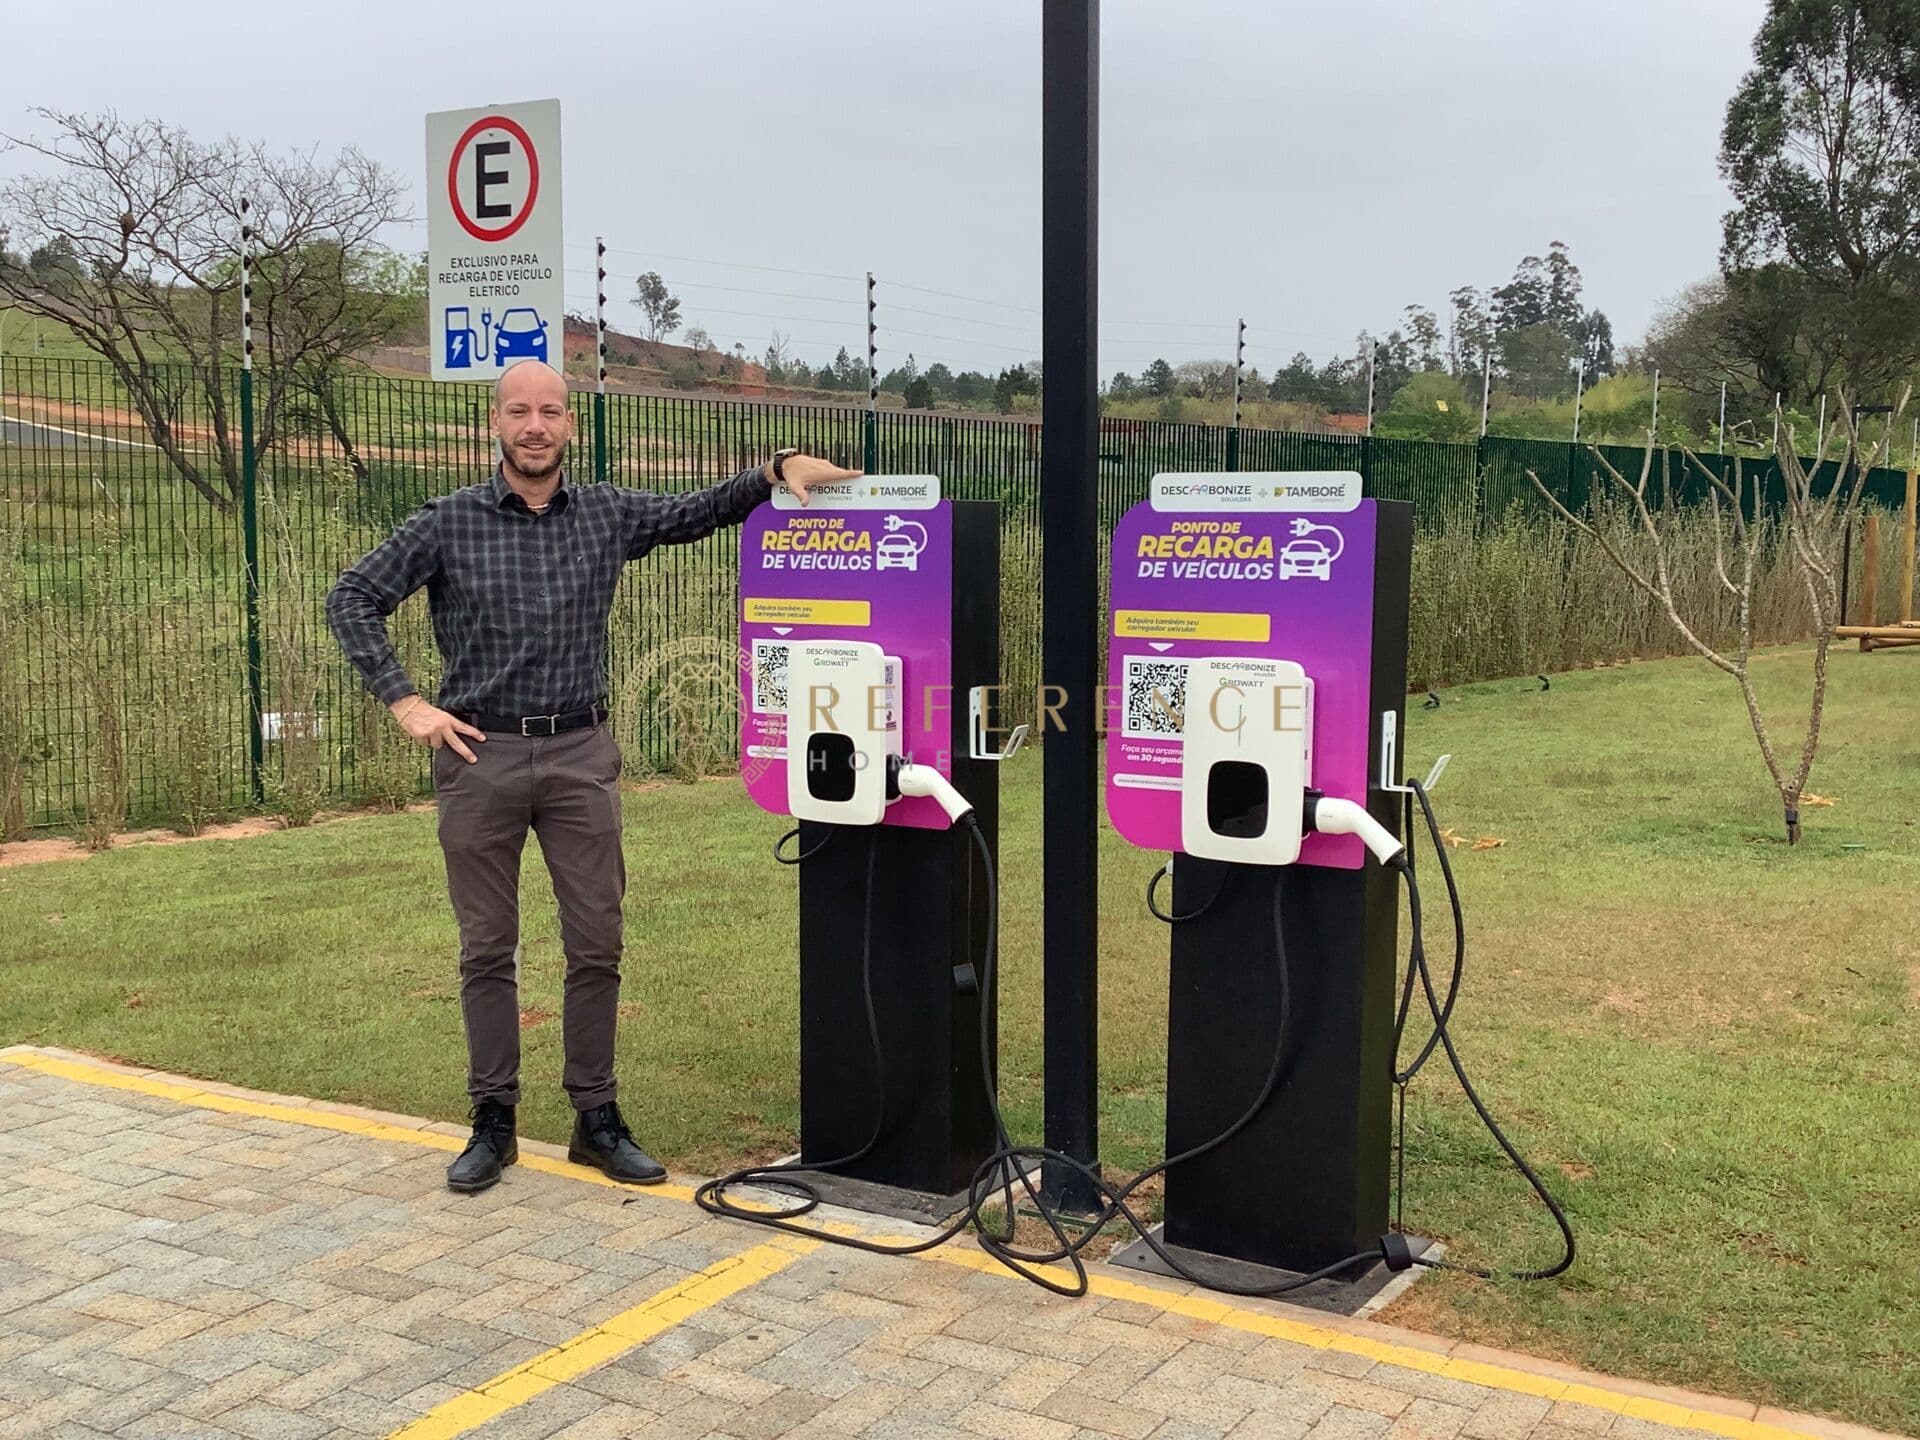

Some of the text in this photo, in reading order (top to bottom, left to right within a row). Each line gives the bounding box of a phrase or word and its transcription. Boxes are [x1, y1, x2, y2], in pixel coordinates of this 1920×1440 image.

[475, 141, 511, 218] E
[450, 253, 539, 269] EXCLUSIVO PARA
[438, 267, 552, 284] RECARGA DE VEÍCULO
[469, 284, 520, 297] ELETRICO
[879, 484, 928, 496] TAMBORÉ
[1160, 483, 1346, 497] DESCARBONIZE TAMBORÉ
[788, 518, 845, 529] PONTO DE
[1171, 522, 1242, 534] PONTO DE
[761, 530, 872, 552] RECARGA
[1137, 535, 1274, 559] RECARGA
[762, 552, 873, 570] DE VEÍCULOS
[1137, 559, 1275, 580] DE VEÍCULOS
[1126, 616, 1154, 625] Adquira
[1155, 617, 1186, 625] também
[1126, 624, 1166, 632] carregador
[1210, 662, 1277, 672] DESCARBONIZE
[1120, 744, 1140, 753] Faça
[1140, 746, 1155, 754] seu
[1140, 753, 1153, 762] 30
